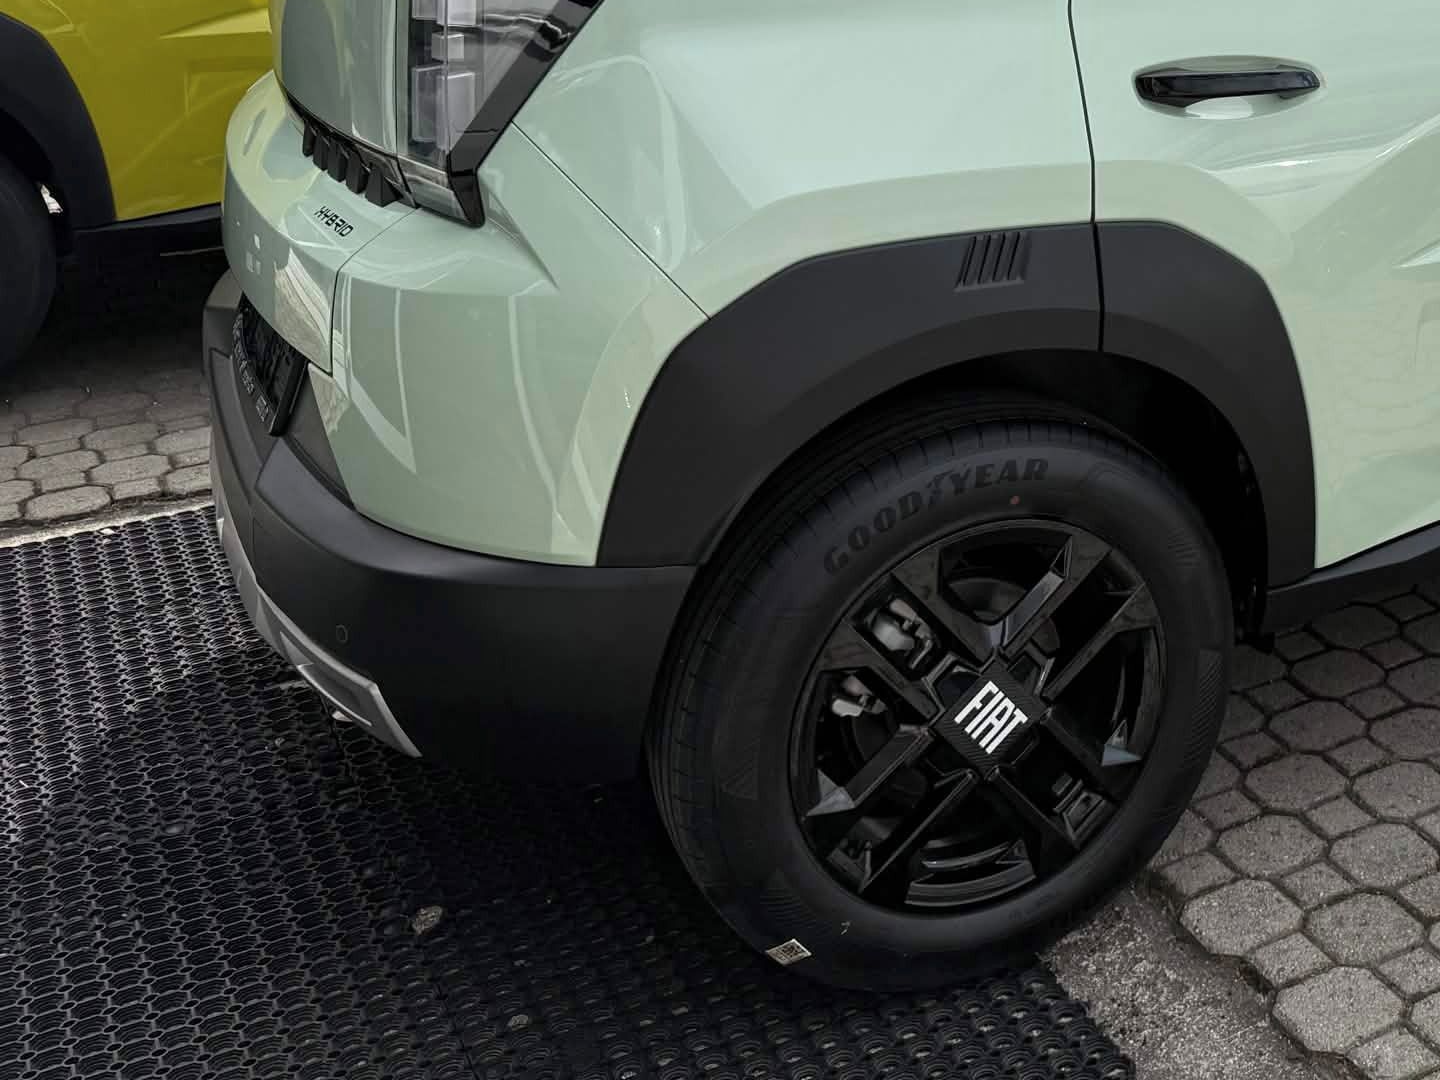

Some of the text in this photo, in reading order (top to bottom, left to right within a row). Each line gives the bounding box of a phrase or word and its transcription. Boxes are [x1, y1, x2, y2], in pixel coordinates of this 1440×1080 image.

[314, 206, 354, 237] HYBRID
[823, 459, 1049, 575] GOODYEAR
[954, 680, 1029, 754] FIAT
